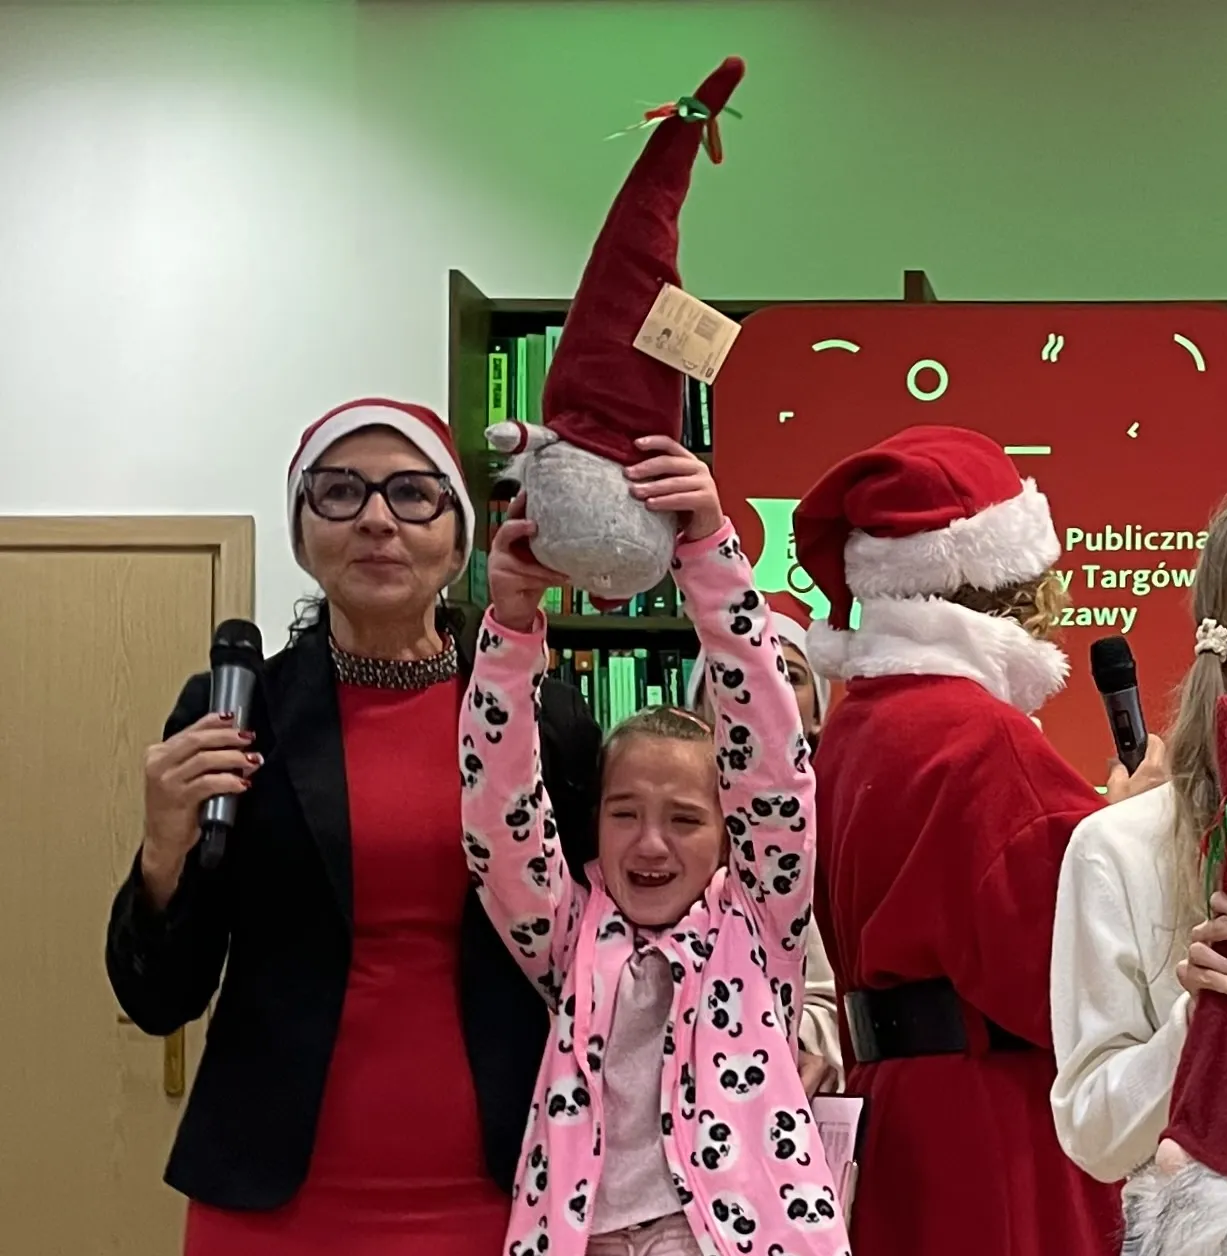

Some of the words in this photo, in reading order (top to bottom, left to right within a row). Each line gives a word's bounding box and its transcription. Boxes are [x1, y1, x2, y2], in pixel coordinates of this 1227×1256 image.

[1066, 524, 1210, 551] Publiczna
[1082, 562, 1197, 596] Targów
[1050, 607, 1138, 634] zawy
